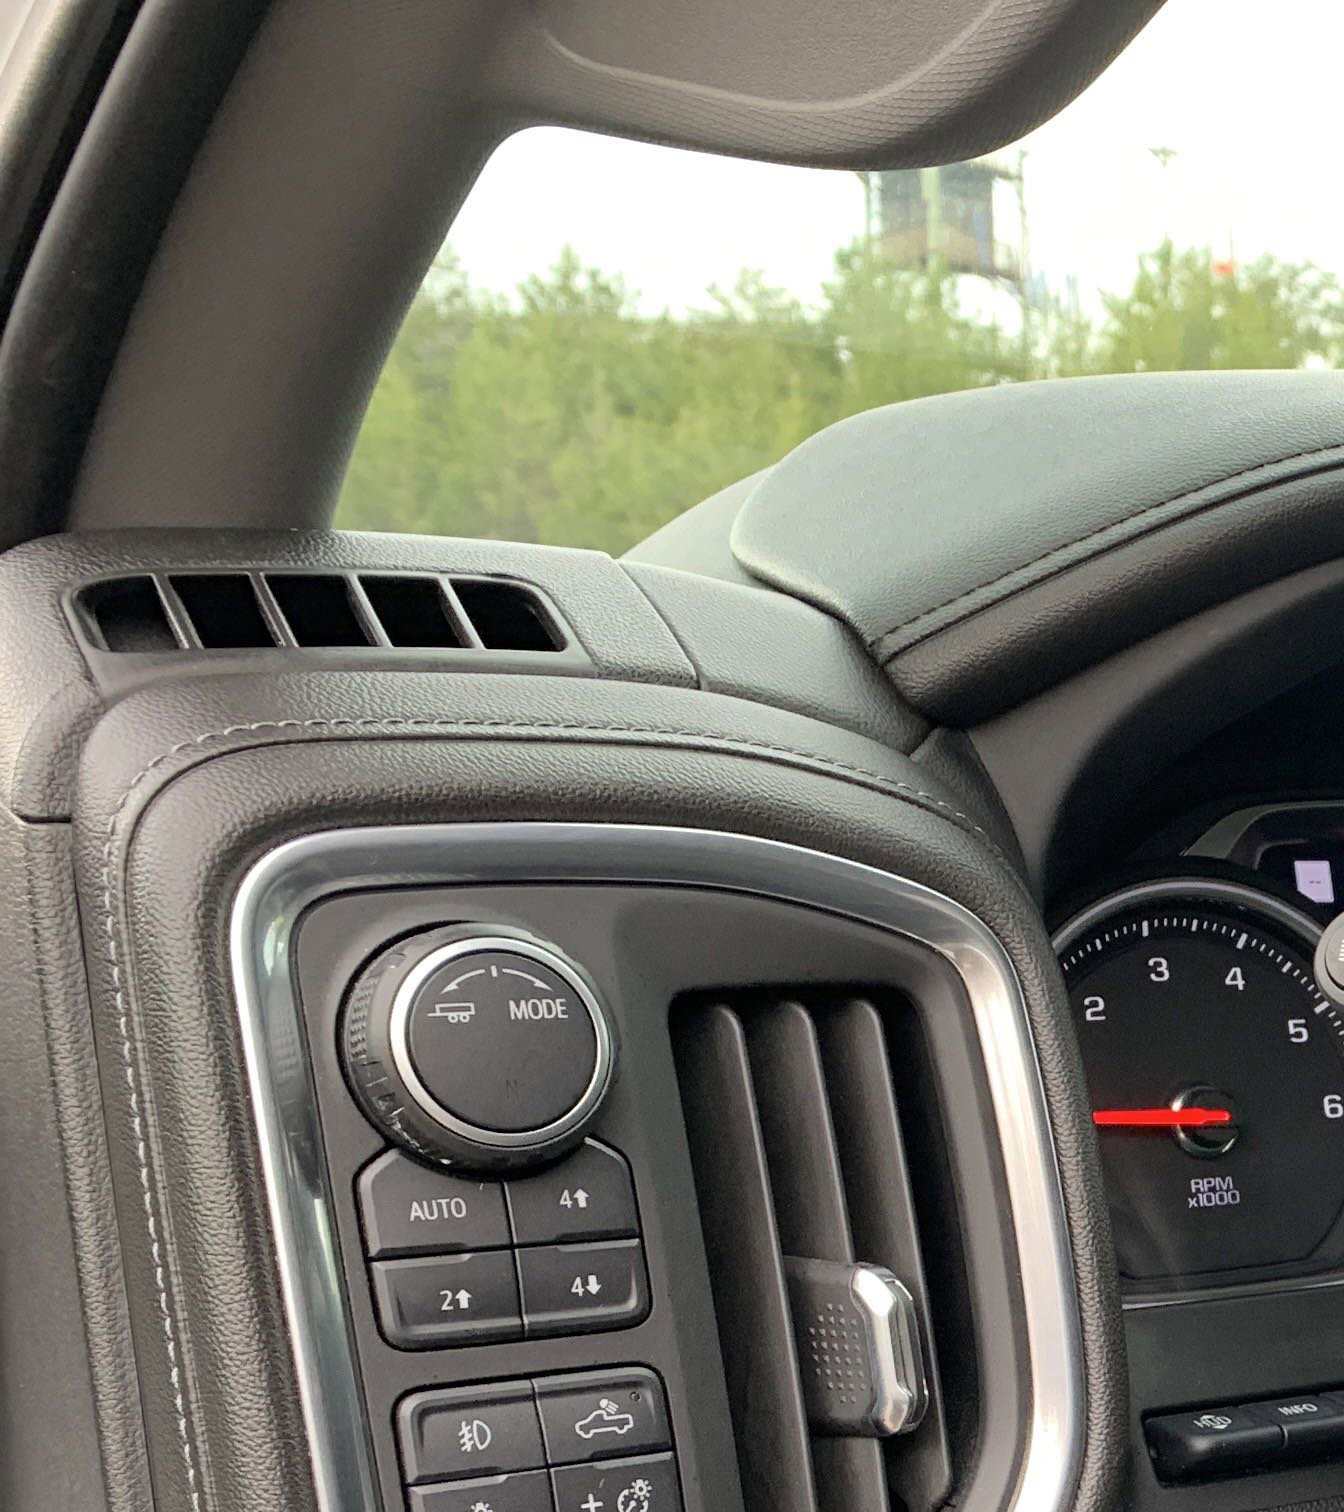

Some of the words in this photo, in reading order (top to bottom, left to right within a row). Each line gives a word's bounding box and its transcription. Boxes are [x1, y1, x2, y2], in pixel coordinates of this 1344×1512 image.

[1148, 957, 1170, 982] 3
[1225, 966, 1246, 991] 4
[509, 999, 568, 1020] MODE
[1083, 996, 1106, 1021] 2
[1288, 1019, 1309, 1043] 5
[1323, 1094, 1344, 1118] 6
[1190, 1176, 1234, 1193] RPM
[410, 1197, 467, 1221] AUTO
[560, 1189, 572, 1208] 4
[1187, 1190, 1240, 1208] x1000
[571, 1277, 584, 1296] 4
[440, 1290, 454, 1311] 2
[1278, 1402, 1318, 1416] INFO
